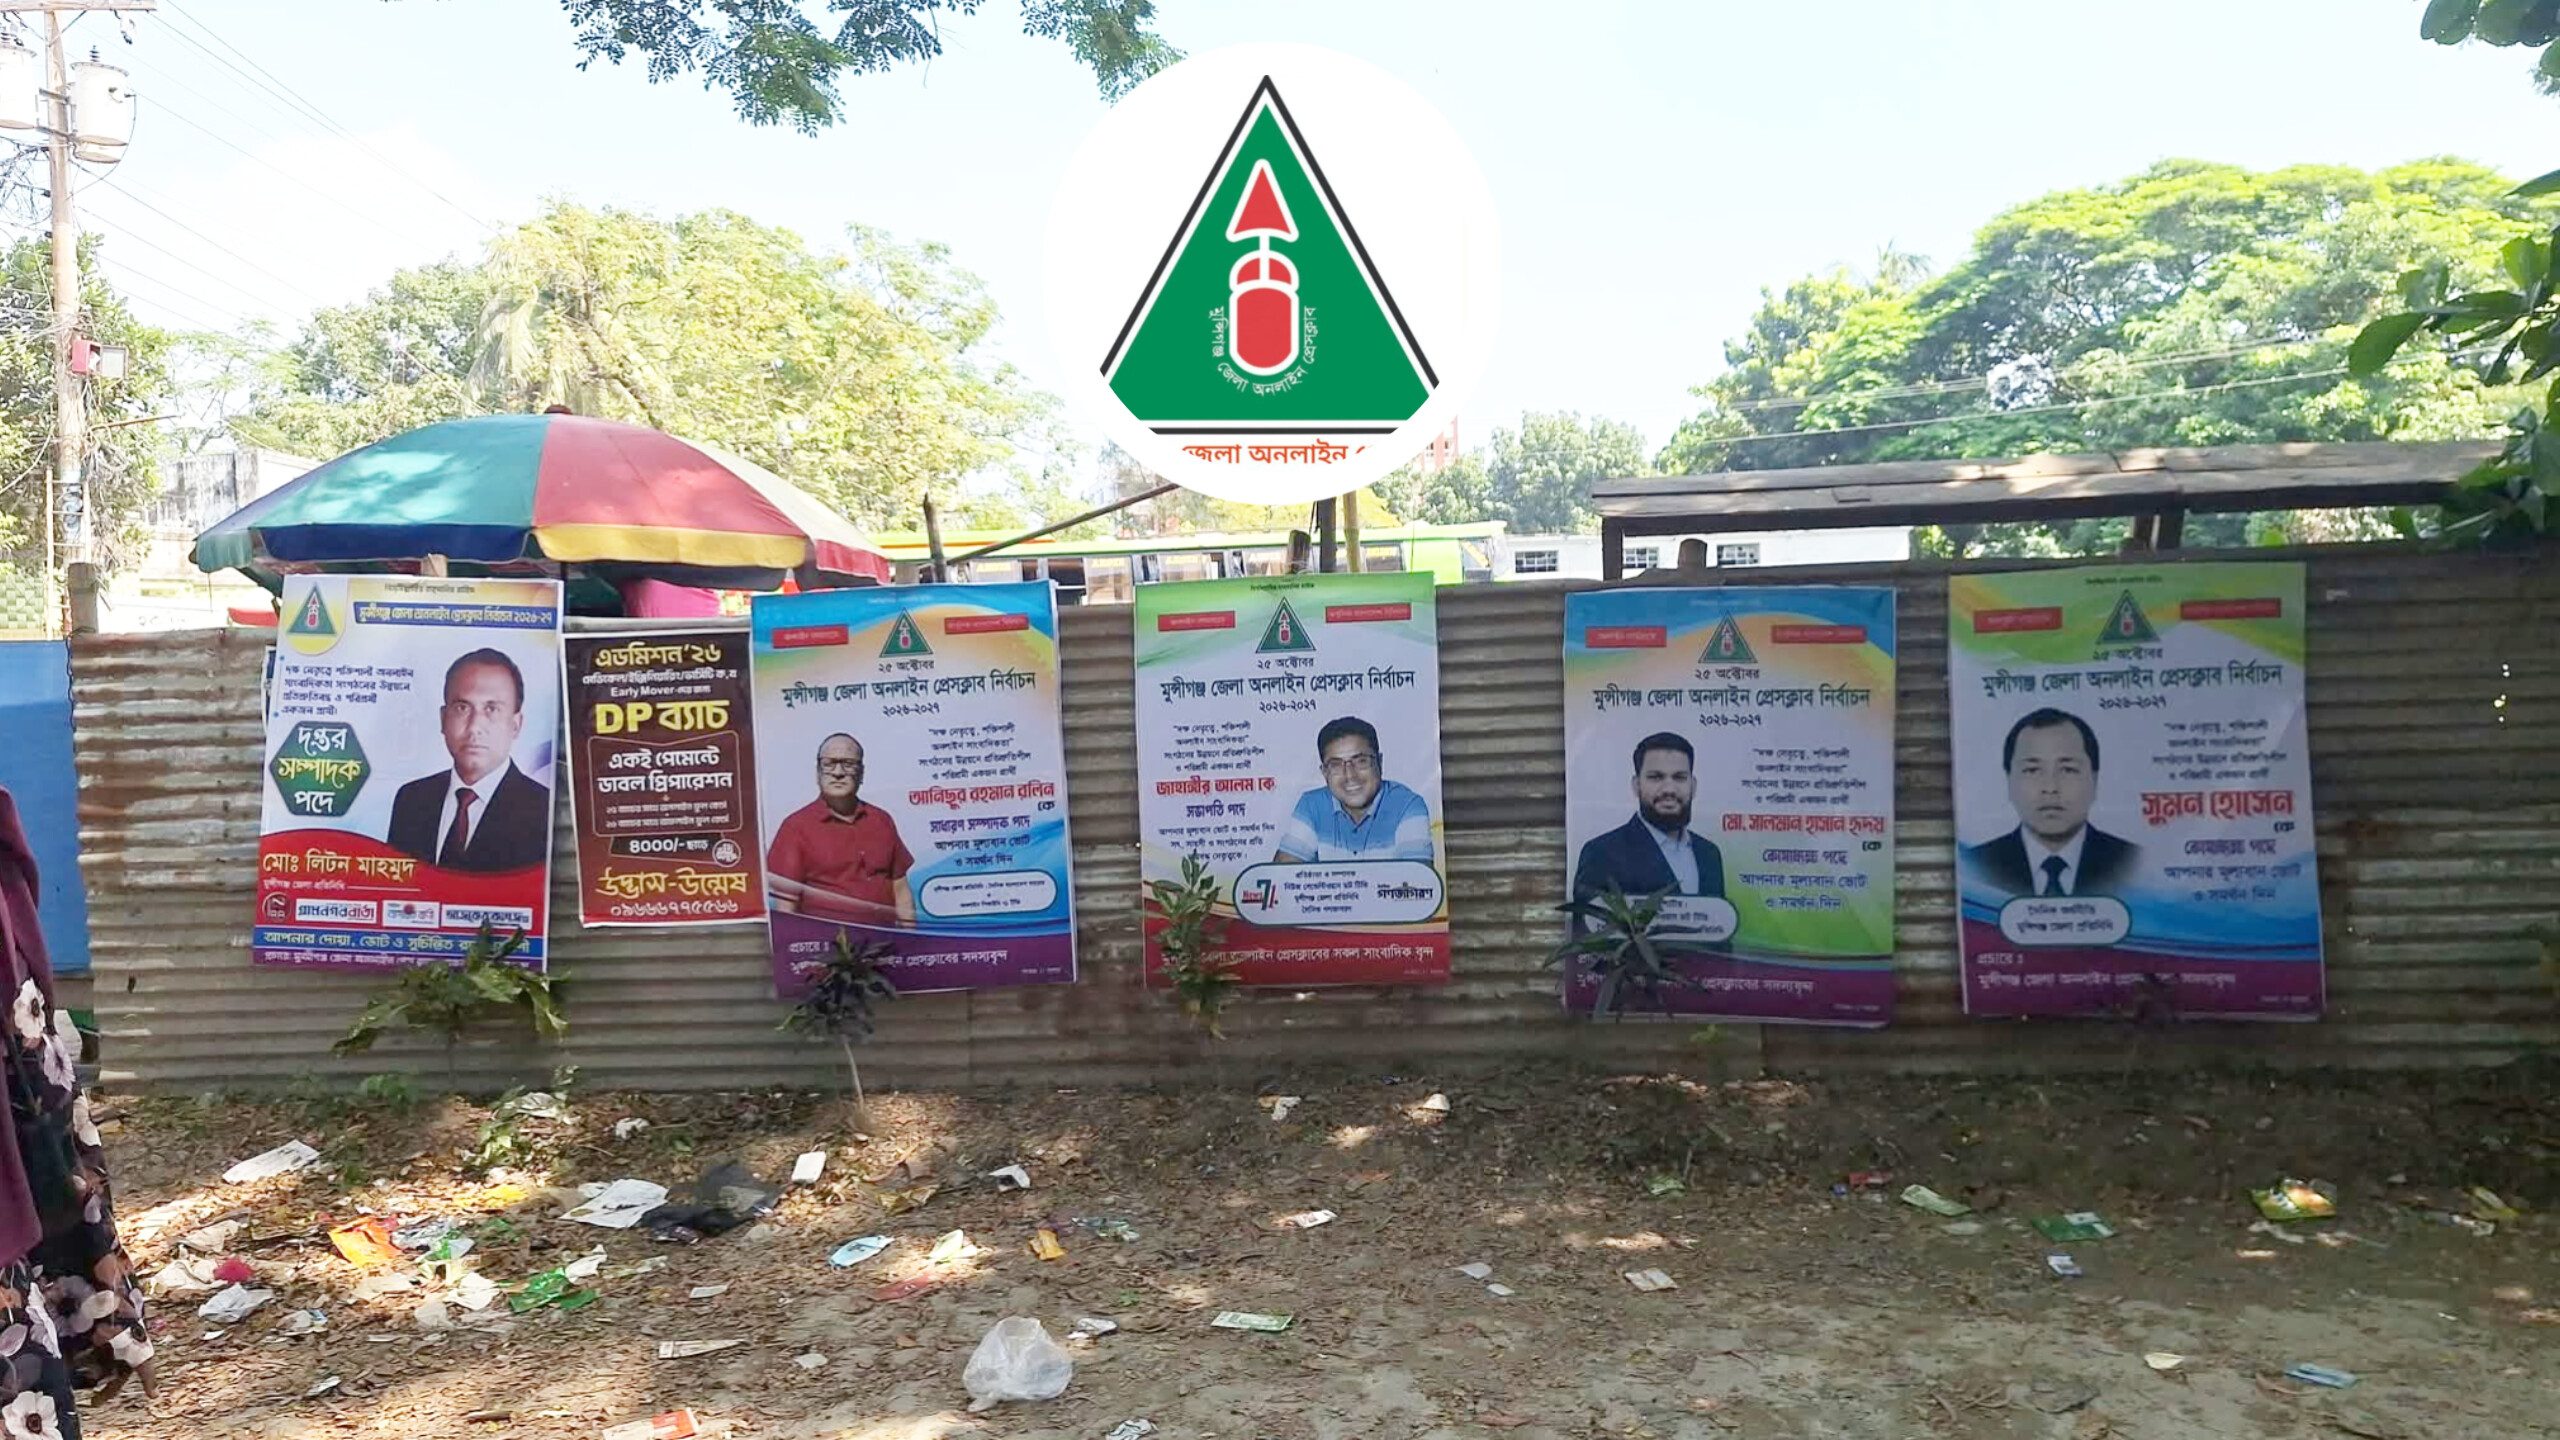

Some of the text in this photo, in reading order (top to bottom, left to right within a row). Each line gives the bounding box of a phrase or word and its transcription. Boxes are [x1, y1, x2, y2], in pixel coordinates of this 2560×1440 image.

[391, 609, 413, 619] জেলা
[879, 659, 934, 672] ২৫ অক্টোবর
[1257, 656, 1314, 669] ২৫ অক্টোবর
[376, 668, 414, 677] অনলাইন
[1694, 667, 1759, 680] ২৫ অক্টোবর
[2042, 673, 2082, 691] জেলা
[2086, 665, 2153, 689] অনলাইন
[2160, 667, 2223, 688] প্রেসক্লাব
[2228, 659, 2283, 685] নির্বাচন
[336, 679, 376, 690] সংগঠনের
[834, 683, 867, 701] জেলা
[872, 676, 928, 698] অনলাইন
[934, 675, 986, 695] প্রেসক্লাব
[990, 667, 1036, 691] নির্বাচন
[1211, 678, 1244, 697] জেলা
[1249, 671, 1305, 694] অনলাইন
[1310, 673, 1364, 692] প্রেসক্লাব
[1367, 665, 1415, 690] নির্বাচন
[610, 686, 639, 698] Early
[1647, 689, 1683, 707] জেলা
[1688, 684, 1750, 707] অনলাইন
[1756, 688, 1814, 708] প্রেসক্লাব
[1819, 682, 1871, 707] নির্বাচন
[281, 706, 314, 714] একজন
[883, 703, 940, 717] ২০২৬-২০২৭
[1259, 699, 1316, 713] ২০২৬-২০২৭
[2098, 695, 2166, 710] ২০২৬-২০২৭
[595, 700, 730, 734] DP ব্যাচ
[1699, 713, 1762, 727] ২০২৬-২০২৭
[298, 726, 348, 757] দপ্তর
[931, 741, 963, 750] অনলাইন
[609, 745, 720, 770] একই পেমেন্টে
[278, 757, 361, 789] সম্পাদক
[597, 768, 733, 793] ডাবল প্রিপারেশন
[1157, 775, 1276, 797] জাহাঙ্গীর আলম কে
[294, 791, 335, 814] পদে
[909, 785, 966, 810] আনিছুর
[970, 784, 1014, 803] রহমান
[1037, 800, 1055, 811] কে
[1186, 799, 1246, 818] সভাপতি পদে
[2141, 790, 2294, 826] সুমন হোসেন
[930, 815, 1030, 835] সাধারণ সম্পাদক পদে
[1158, 826, 1185, 836] আপনার
[1213, 824, 1229, 834] ভোট
[1722, 814, 1746, 832] মো.
[1748, 814, 1801, 832] সালমান
[2274, 821, 2295, 833] কে
[935, 834, 1030, 851] আপনার মূল্যবান ভোট
[1862, 841, 1881, 851] কে
[2250, 839, 2277, 854] পদে
[263, 847, 419, 883] মোঃ লিটন মাহমুদ
[966, 855, 993, 867] সমর্থন
[995, 852, 1014, 864] দিন
[1822, 850, 1848, 865] পদে
[2164, 866, 2213, 879] আপনার
[1739, 873, 1785, 886] আপনার
[1838, 873, 1868, 888] ভোট
[610, 900, 738, 916] ০৯৬৬৬৭৭৫৫৬৬
[263, 932, 315, 943] আপনার
[360, 934, 390, 947] ভোট
[393, 938, 403, 947] ও
[408, 934, 453, 952] সুচিন্তিত
[906, 950, 1008, 968] প্রেসক্লাবের সদস্যবৃন্দ
[1363, 943, 1411, 960] সাংবাদিক
